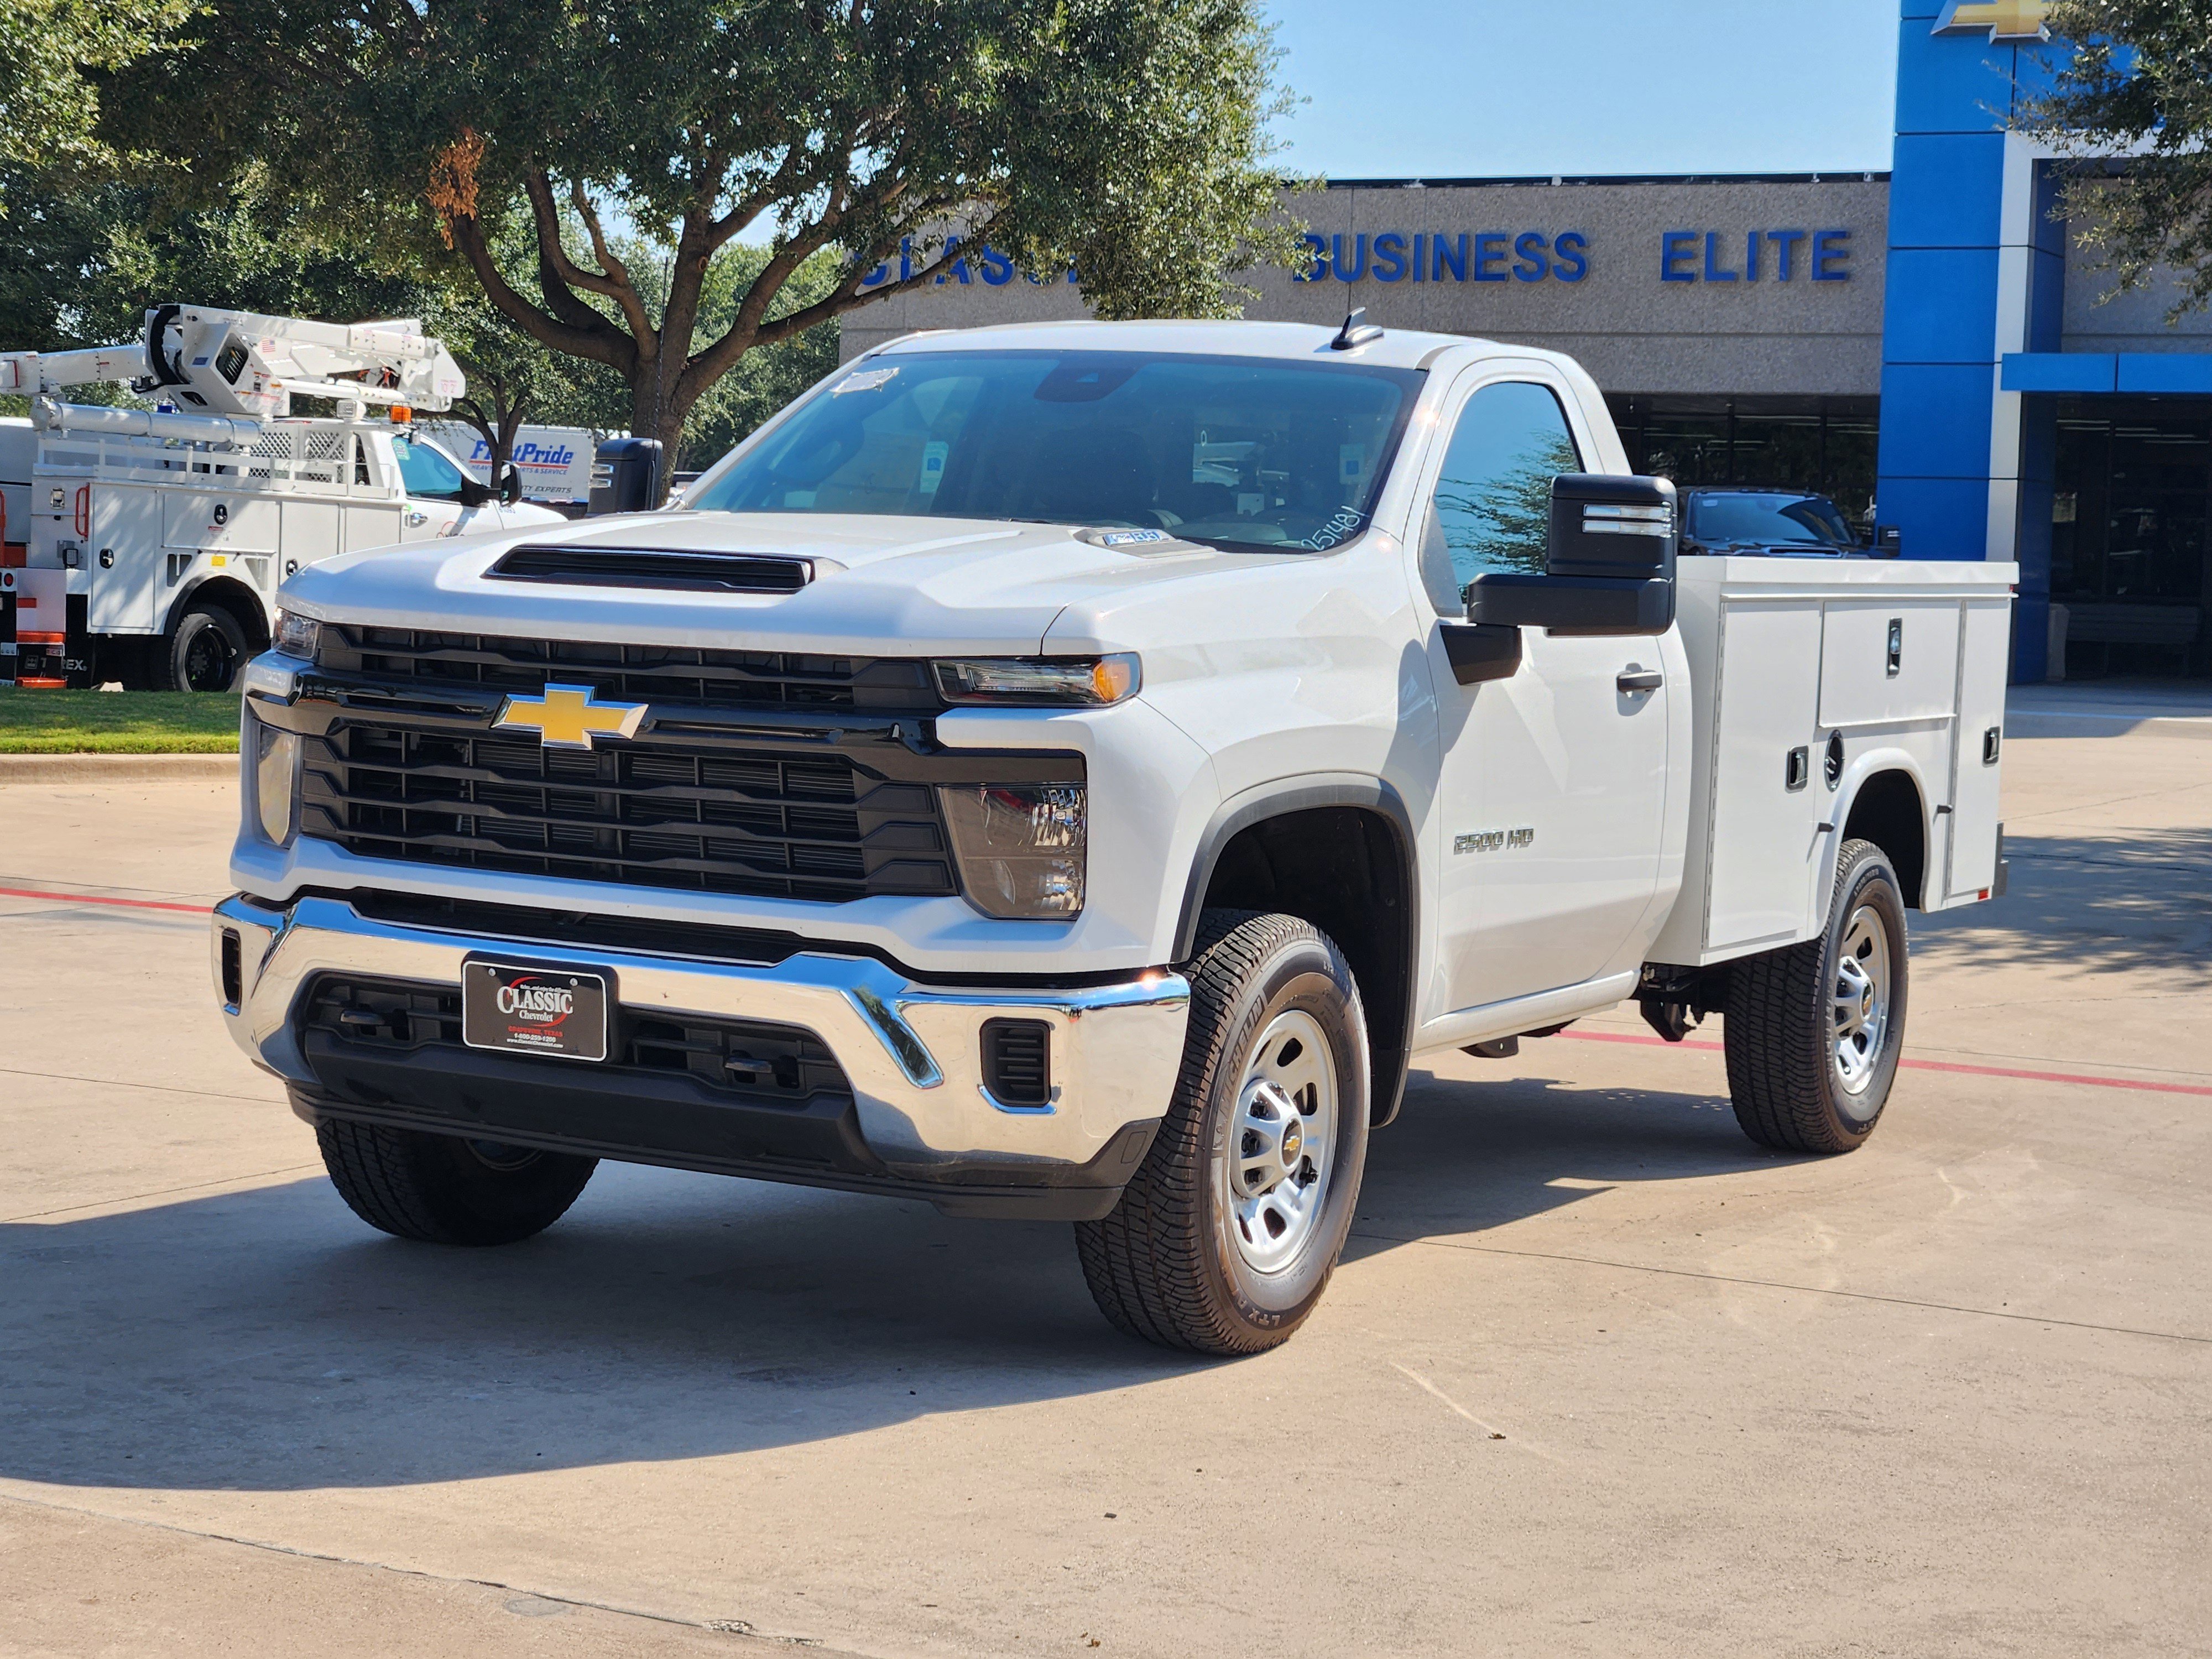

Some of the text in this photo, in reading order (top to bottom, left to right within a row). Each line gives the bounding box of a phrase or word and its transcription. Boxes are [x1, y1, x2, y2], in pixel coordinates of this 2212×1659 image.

[1293, 232, 1586, 283] BUSINESS
[1661, 230, 1849, 282] ELITE
[535, 486, 572, 494] EXPERTS
[1301, 505, 1370, 551] 251481
[1454, 826, 1534, 850] 2500 HD
[497, 986, 573, 1014] CLASSIC
[519, 1010, 554, 1022] Chevrolet
[1219, 994, 1266, 1120] MICHELIN
[1248, 1307, 1281, 1326] LTX
